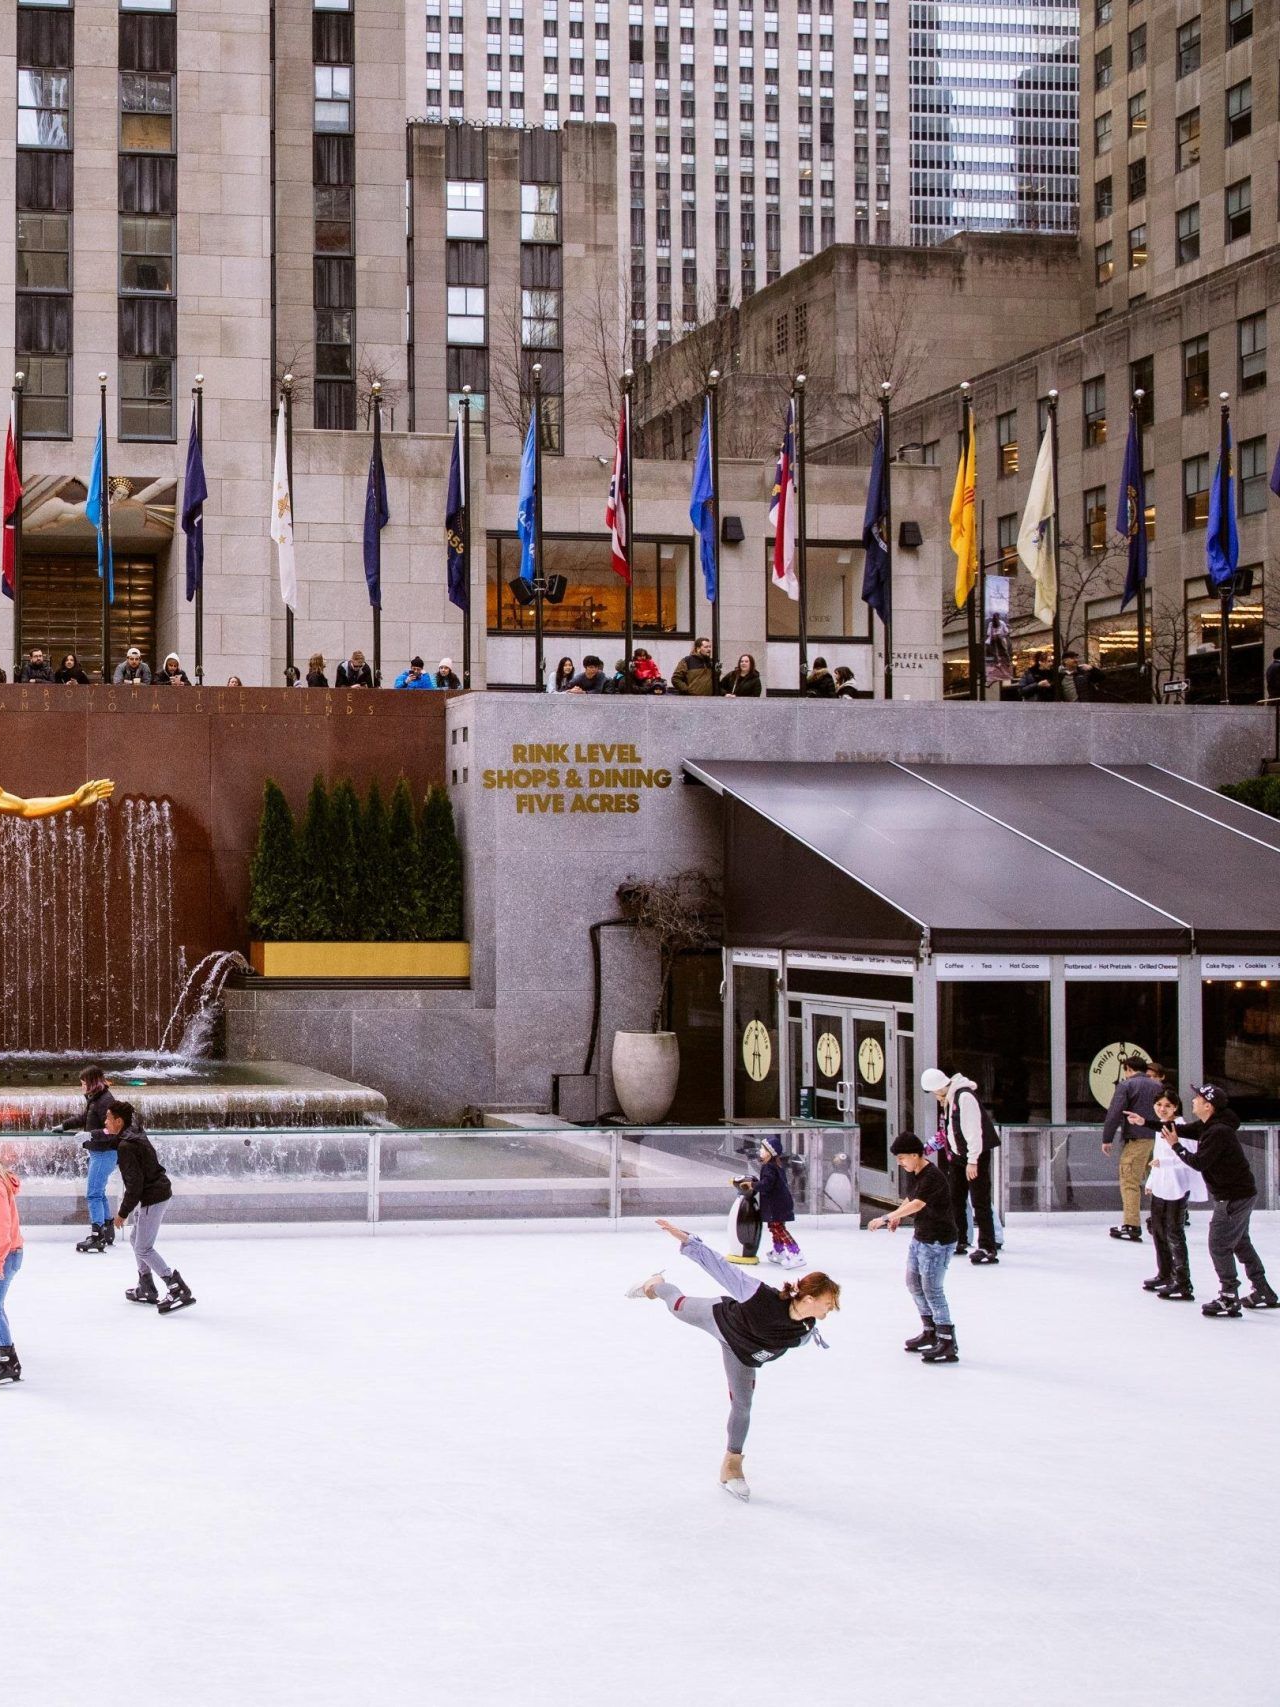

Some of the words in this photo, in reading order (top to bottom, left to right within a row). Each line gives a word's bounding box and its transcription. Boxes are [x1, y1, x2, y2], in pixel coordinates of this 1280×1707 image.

[878, 652, 939, 660] RCKEFELLER
[512, 744, 570, 764] RINK
[574, 744, 642, 764] LEVEL
[481, 769, 560, 789] SHOPS
[565, 769, 583, 788] &
[588, 768, 672, 789] DINING
[516, 794, 565, 814] FIVE
[569, 793, 640, 814] ACRES
[1221, 962, 1235, 970] Pops
[1093, 1050, 1114, 1075] Smith
